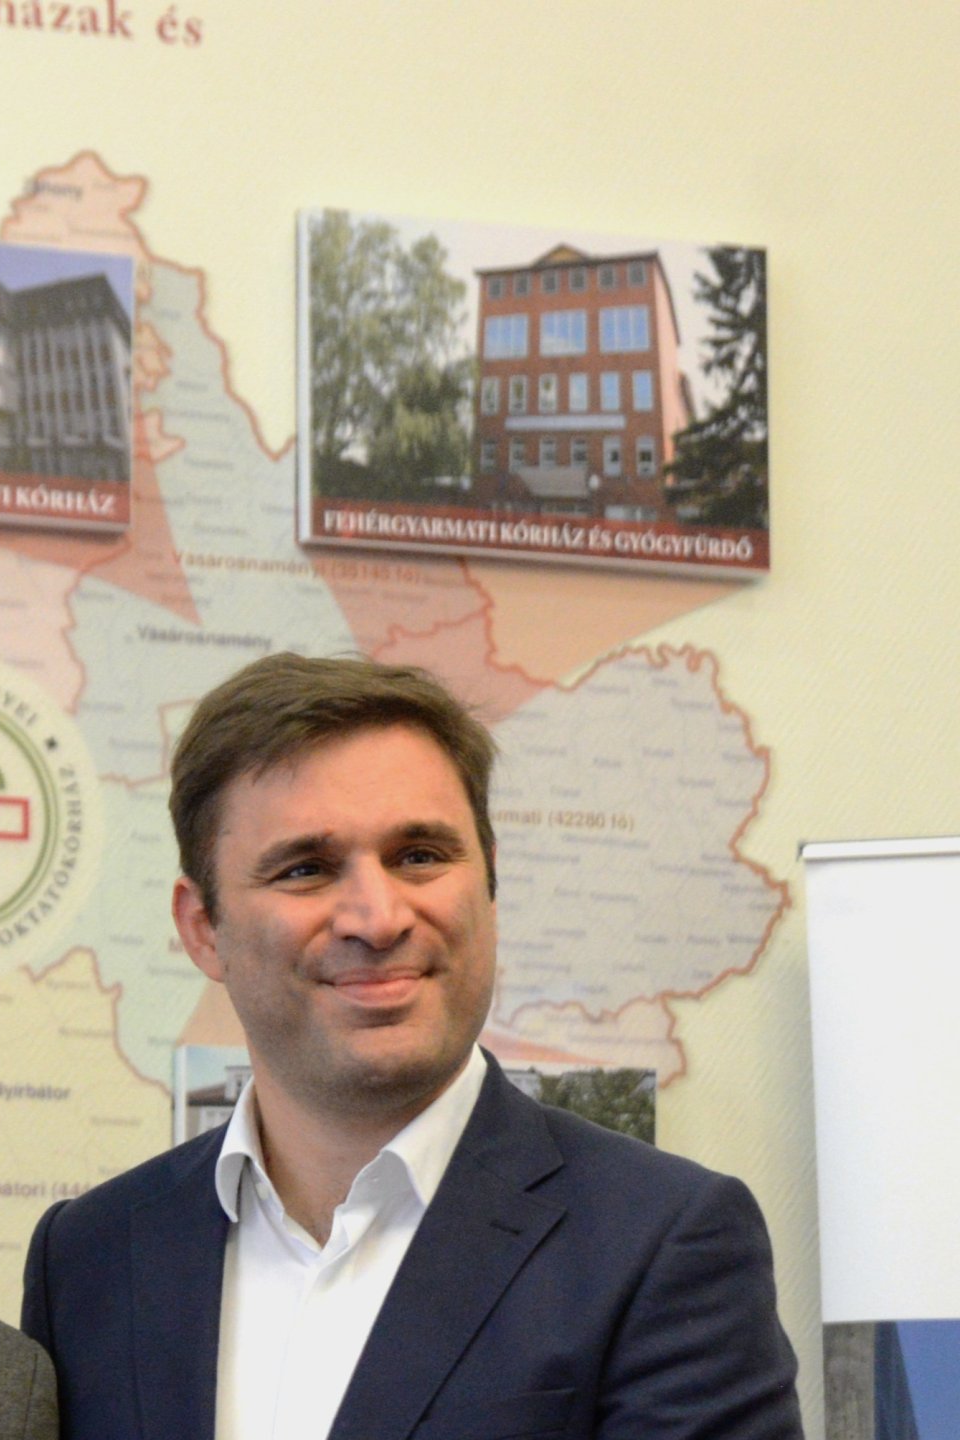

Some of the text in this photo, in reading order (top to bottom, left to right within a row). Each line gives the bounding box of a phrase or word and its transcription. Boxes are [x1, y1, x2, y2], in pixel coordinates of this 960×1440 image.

[155, 4, 205, 46] és
[15, 482, 116, 515] KÓRHÁZ
[324, 509, 496, 543] FEHÉRGYARMATI
[500, 519, 585, 549] KÓRHÁZ
[589, 525, 613, 551] ÉS
